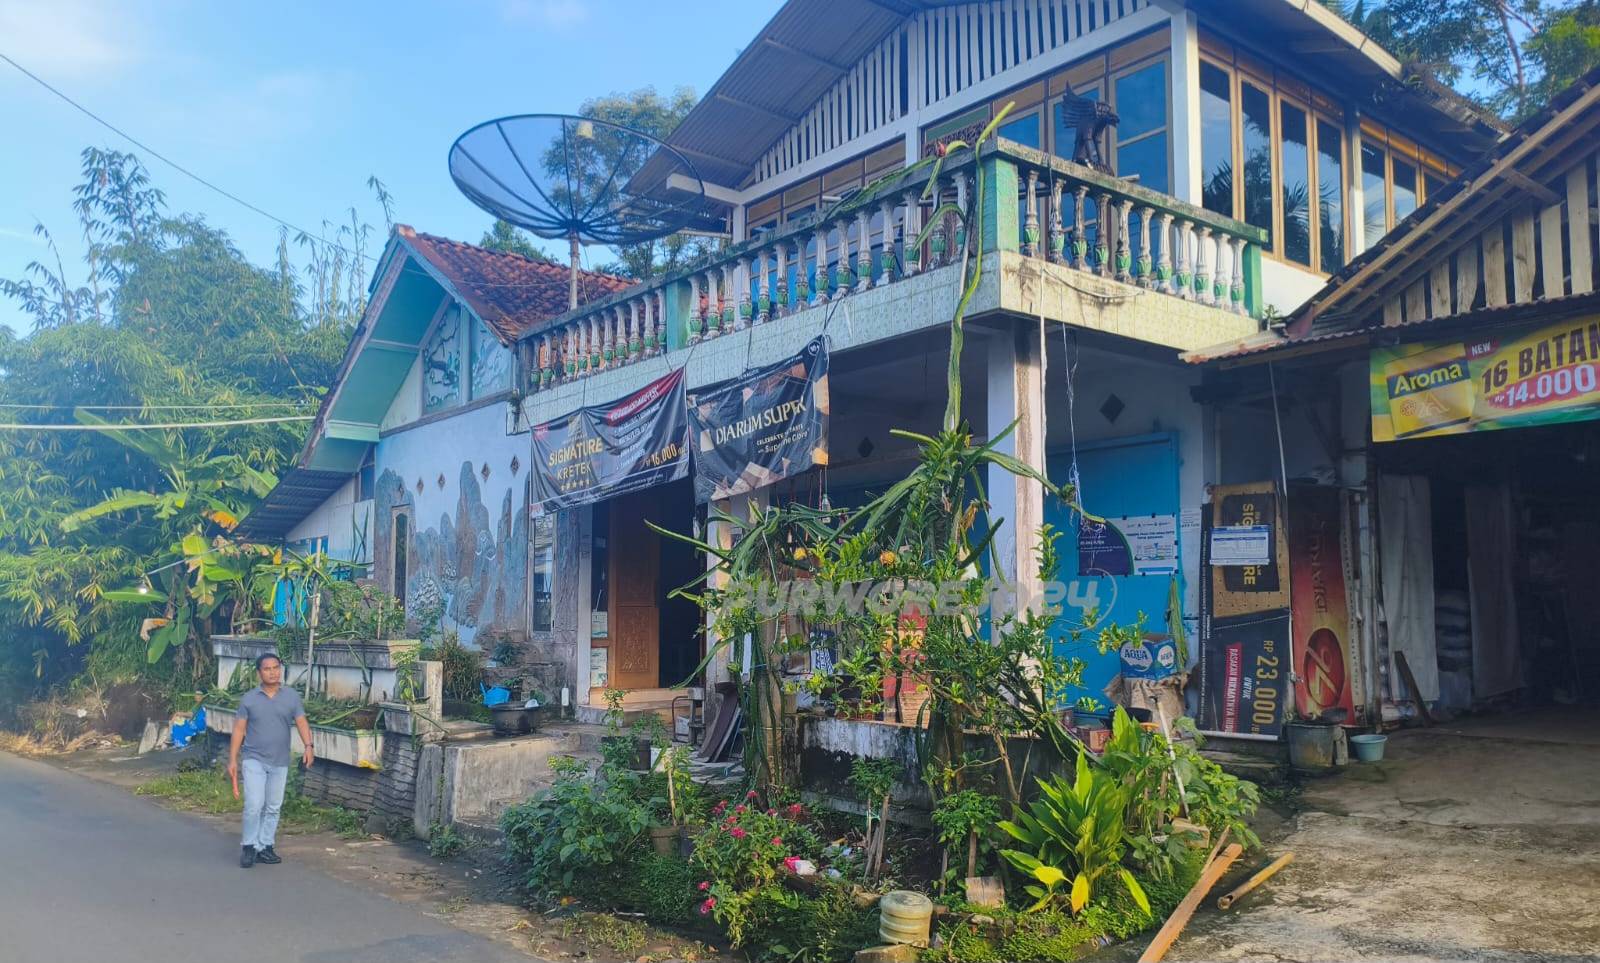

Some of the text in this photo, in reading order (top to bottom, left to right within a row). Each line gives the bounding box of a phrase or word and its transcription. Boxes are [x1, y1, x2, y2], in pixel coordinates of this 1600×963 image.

[1471, 342, 1491, 356] NEW
[1394, 363, 1463, 395] Aroma
[1482, 360, 1508, 393] 16
[1506, 364, 1597, 406] 14.000
[716, 413, 763, 445] DJARUM
[548, 436, 604, 467] SIGNATURE
[557, 461, 591, 481] KRETEK
[1242, 503, 1256, 585] SIGRE
[1124, 647, 1149, 661] AQUA
[1263, 640, 1274, 653] RP
[1242, 676, 1252, 700] UNTUK
